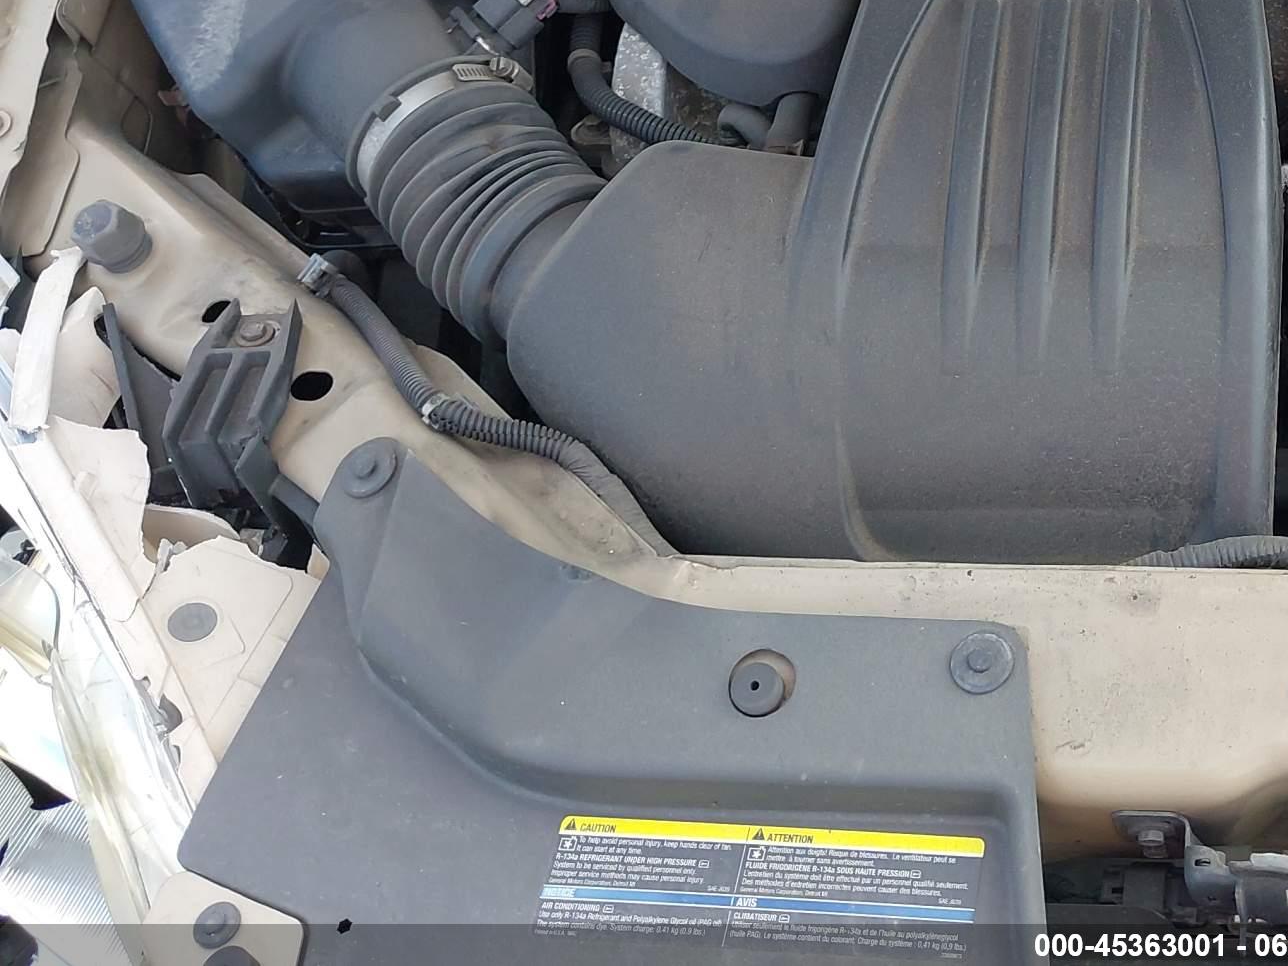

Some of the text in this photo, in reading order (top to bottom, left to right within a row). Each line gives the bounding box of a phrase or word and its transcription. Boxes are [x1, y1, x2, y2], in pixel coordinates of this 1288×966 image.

[580, 823, 617, 833] CAUTION
[587, 837, 601, 845] help
[602, 837, 618, 845] avoid
[618, 839, 644, 847] personal
[663, 840, 678, 849] keep
[767, 834, 814, 843] ATTENTION
[579, 854, 624, 862] REFRIGERANT
[624, 856, 646, 864] UNDER
[647, 857, 663, 865] HIGH
[663, 858, 698, 866] PRESSURE
[934, 856, 948, 864] peut
[553, 861, 576, 869] System
[627, 864, 652, 872] qualified
[745, 861, 768, 870] FLUIDE
[836, 867, 854, 875] SOUS
[855, 868, 876, 876] HAUTE
[551, 869, 578, 877] Improper
[810, 873, 822, 881] doit
[862, 877, 871, 885] par
[882, 878, 911, 887] personnel
[899, 886, 911, 894] des
[541, 901, 600, 912] AIR CONDITIONING
[736, 898, 757, 907] AVIS
[539, 910, 550, 918] Use
[551, 911, 564, 919] only
[564, 911, 587, 919] R-134a
[587, 913, 620, 922] Refrigerant
[632, 915, 669, 924] Polyalkylene
[670, 917, 689, 925] Glycol
[734, 912, 778, 921] CLIMATISEUR
[537, 919, 546, 927] The
[610, 924, 632, 932] System
[671, 927, 679, 935] kg
